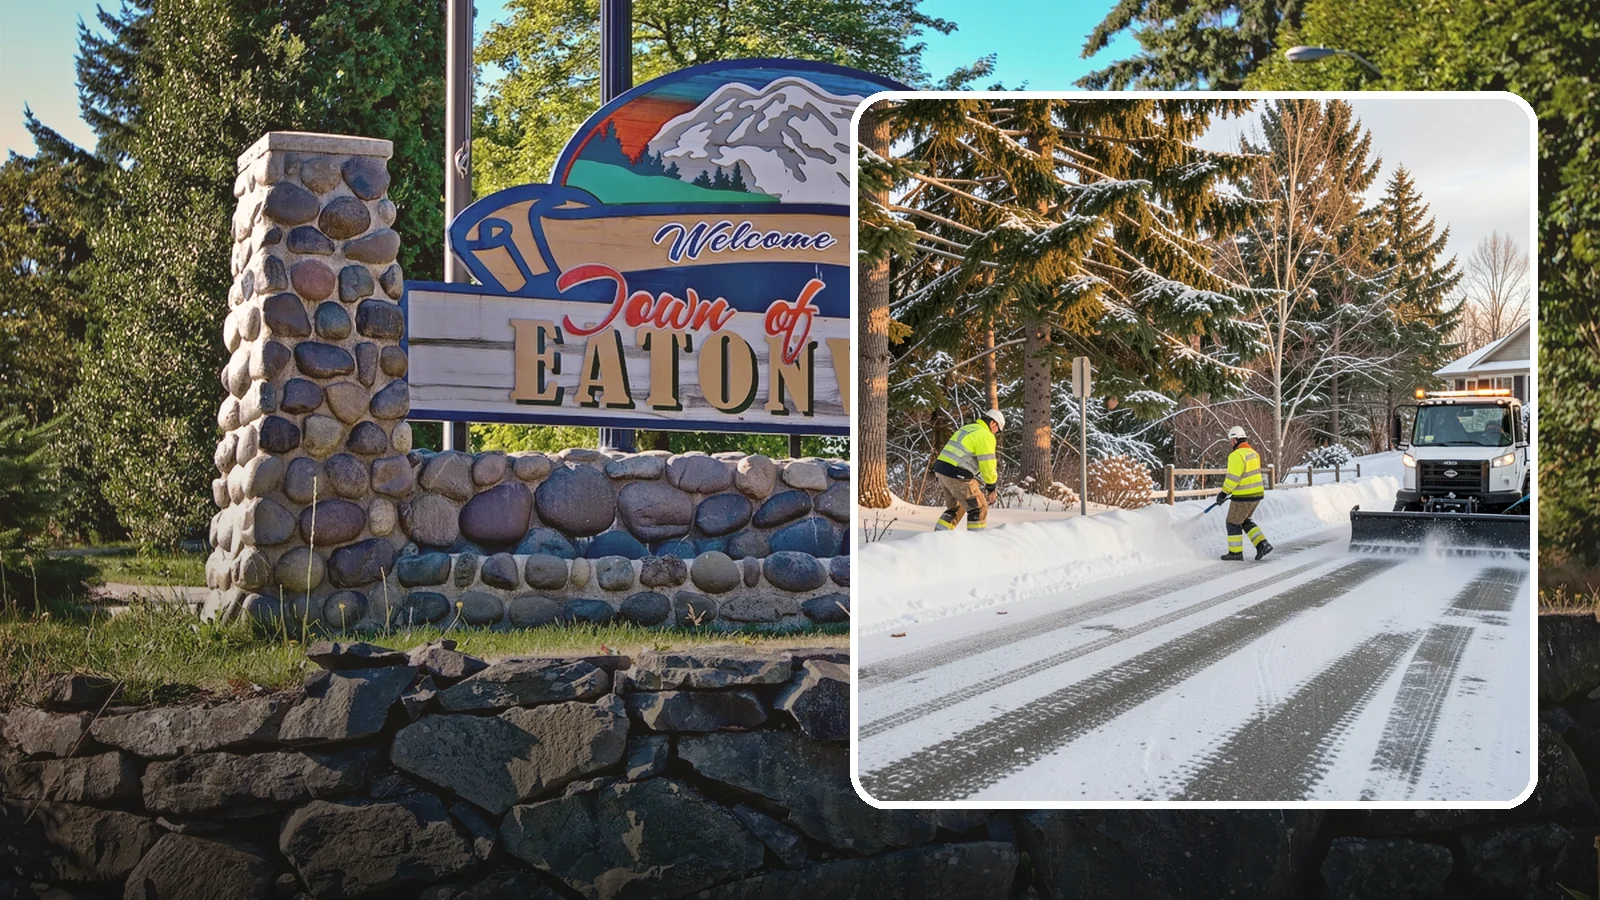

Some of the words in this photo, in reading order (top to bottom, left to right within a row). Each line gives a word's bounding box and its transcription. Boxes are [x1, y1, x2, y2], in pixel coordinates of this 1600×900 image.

[653, 220, 837, 263] Welcome
[558, 263, 737, 336] Town
[764, 278, 826, 365] of
